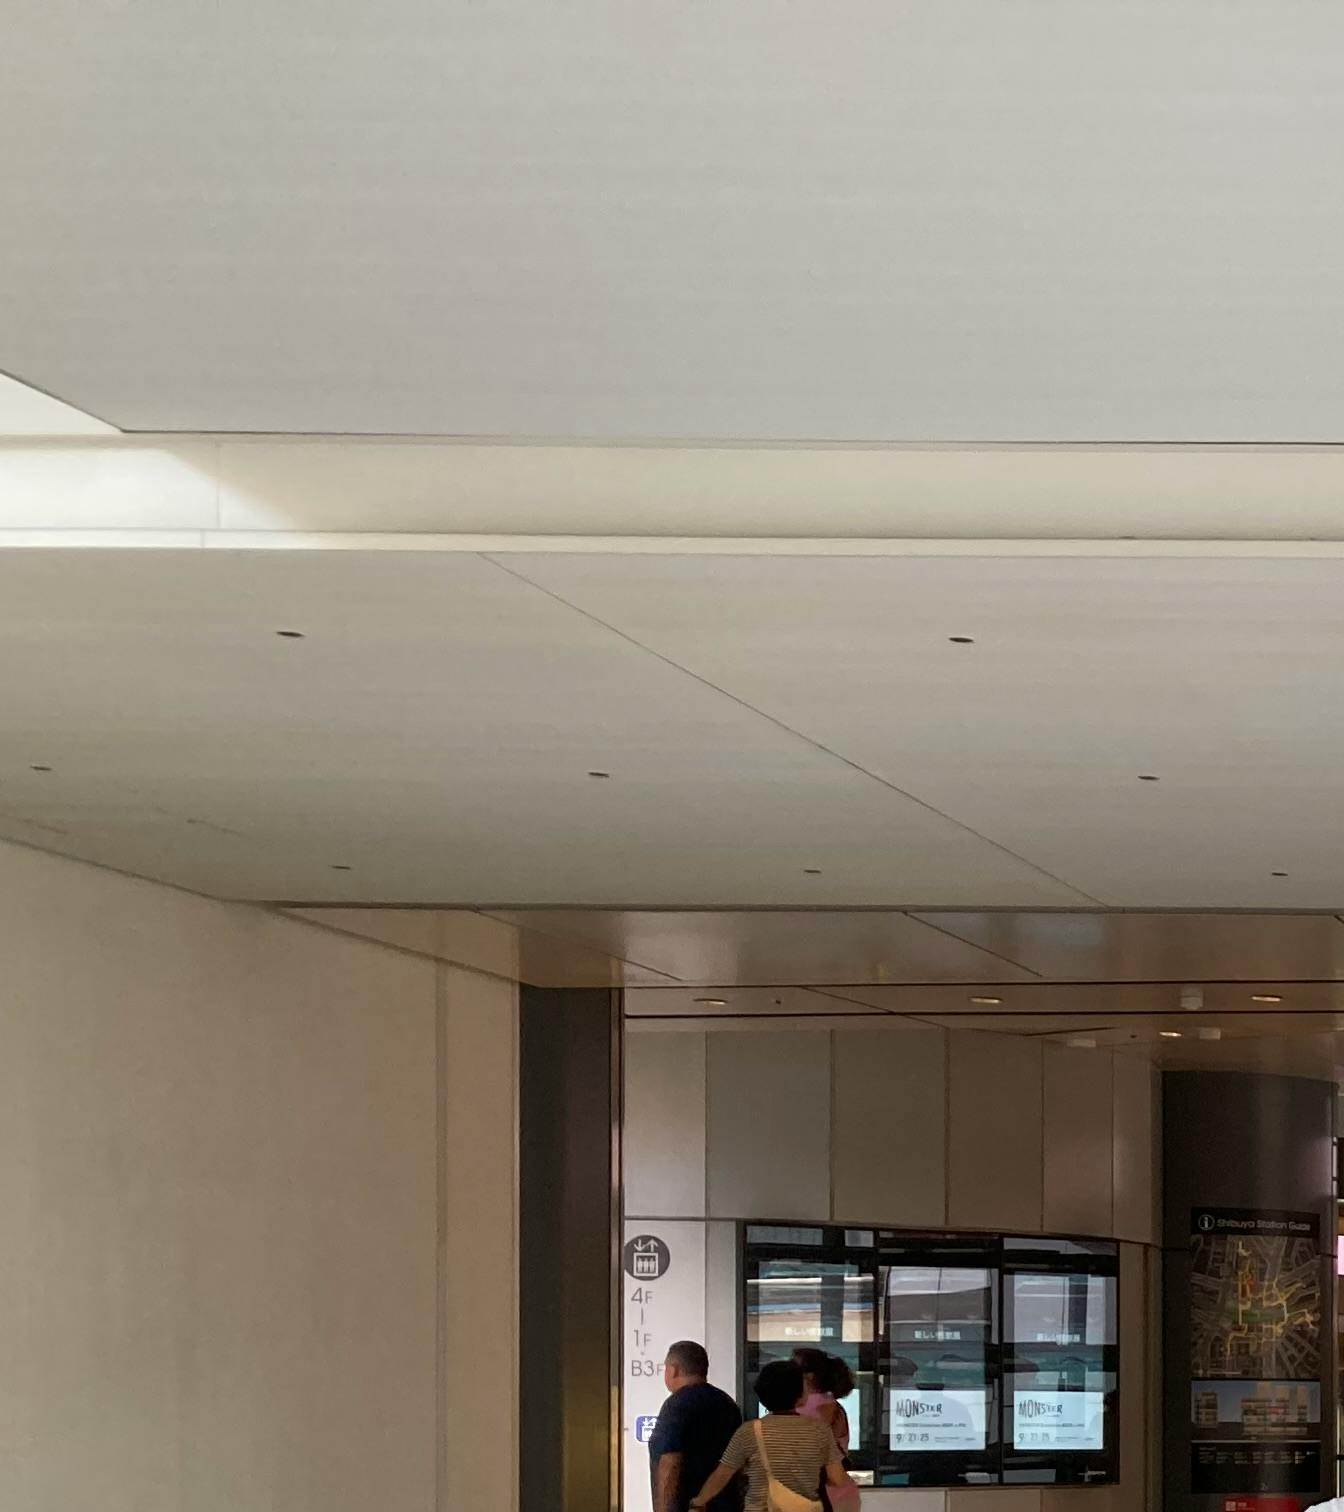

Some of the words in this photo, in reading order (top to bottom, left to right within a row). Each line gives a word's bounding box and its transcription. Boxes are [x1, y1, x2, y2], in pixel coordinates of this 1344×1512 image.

[631, 1287, 653, 1304] 4F
[633, 1329, 652, 1347] 1F
[631, 1359, 664, 1377] B3F
[896, 1398, 943, 1418] MONSTER
[1018, 1400, 1063, 1418] MONSTER
